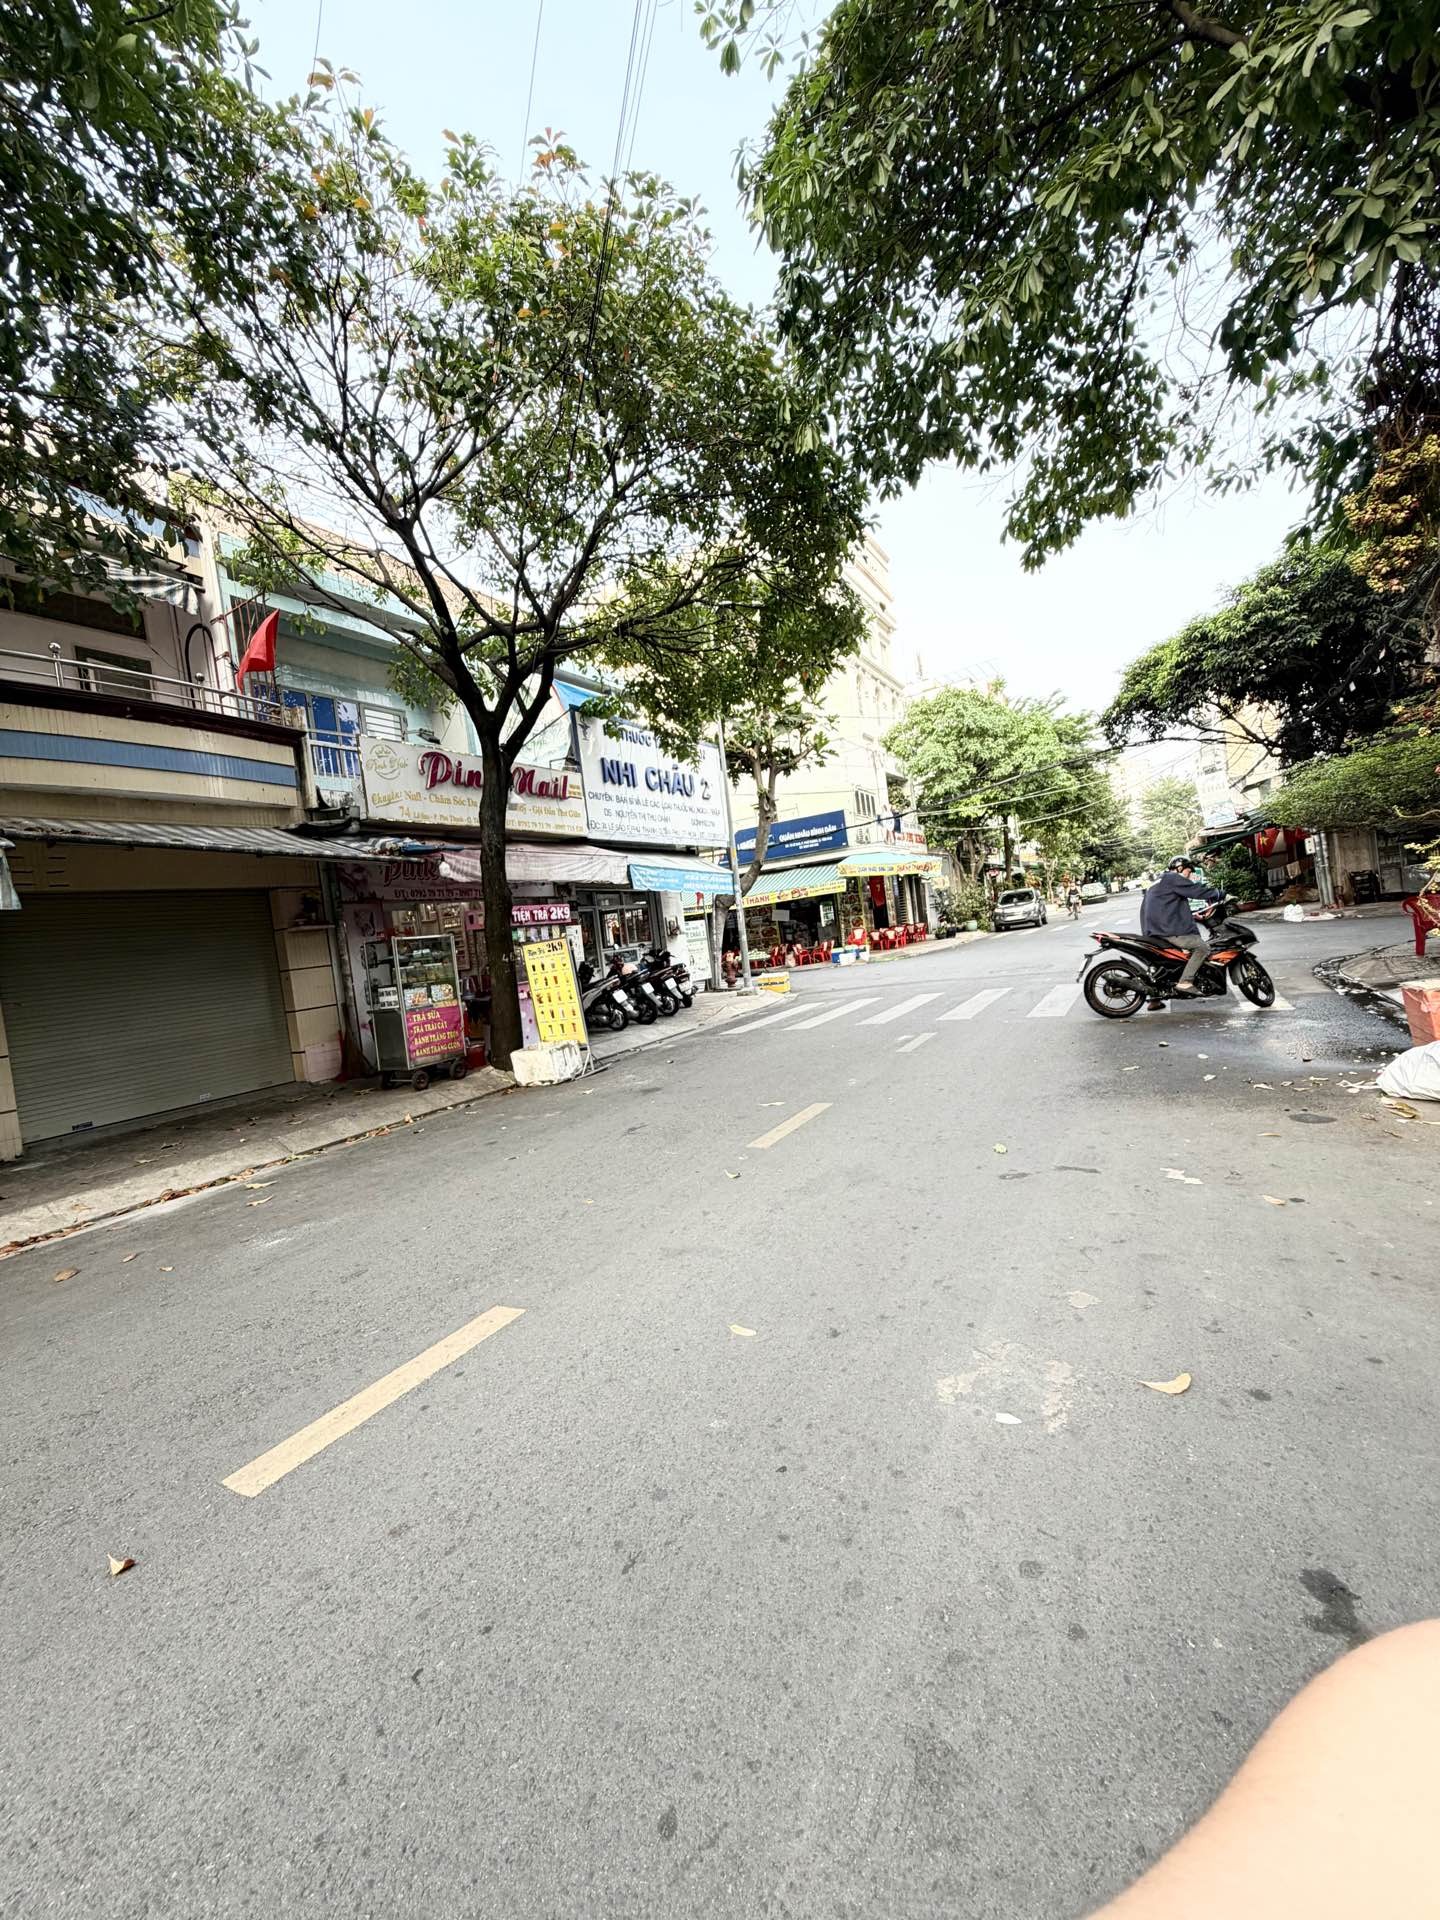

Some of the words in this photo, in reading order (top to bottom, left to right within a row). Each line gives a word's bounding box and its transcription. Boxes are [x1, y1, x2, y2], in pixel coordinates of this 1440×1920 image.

[418, 751, 484, 790] Pin
[512, 766, 569, 801] Nail
[600, 757, 638, 788] NHI
[645, 764, 695, 797] CHÂU
[700, 778, 711, 801] 2
[533, 906, 548, 921] TRÀ
[550, 906, 570, 920] 2K9
